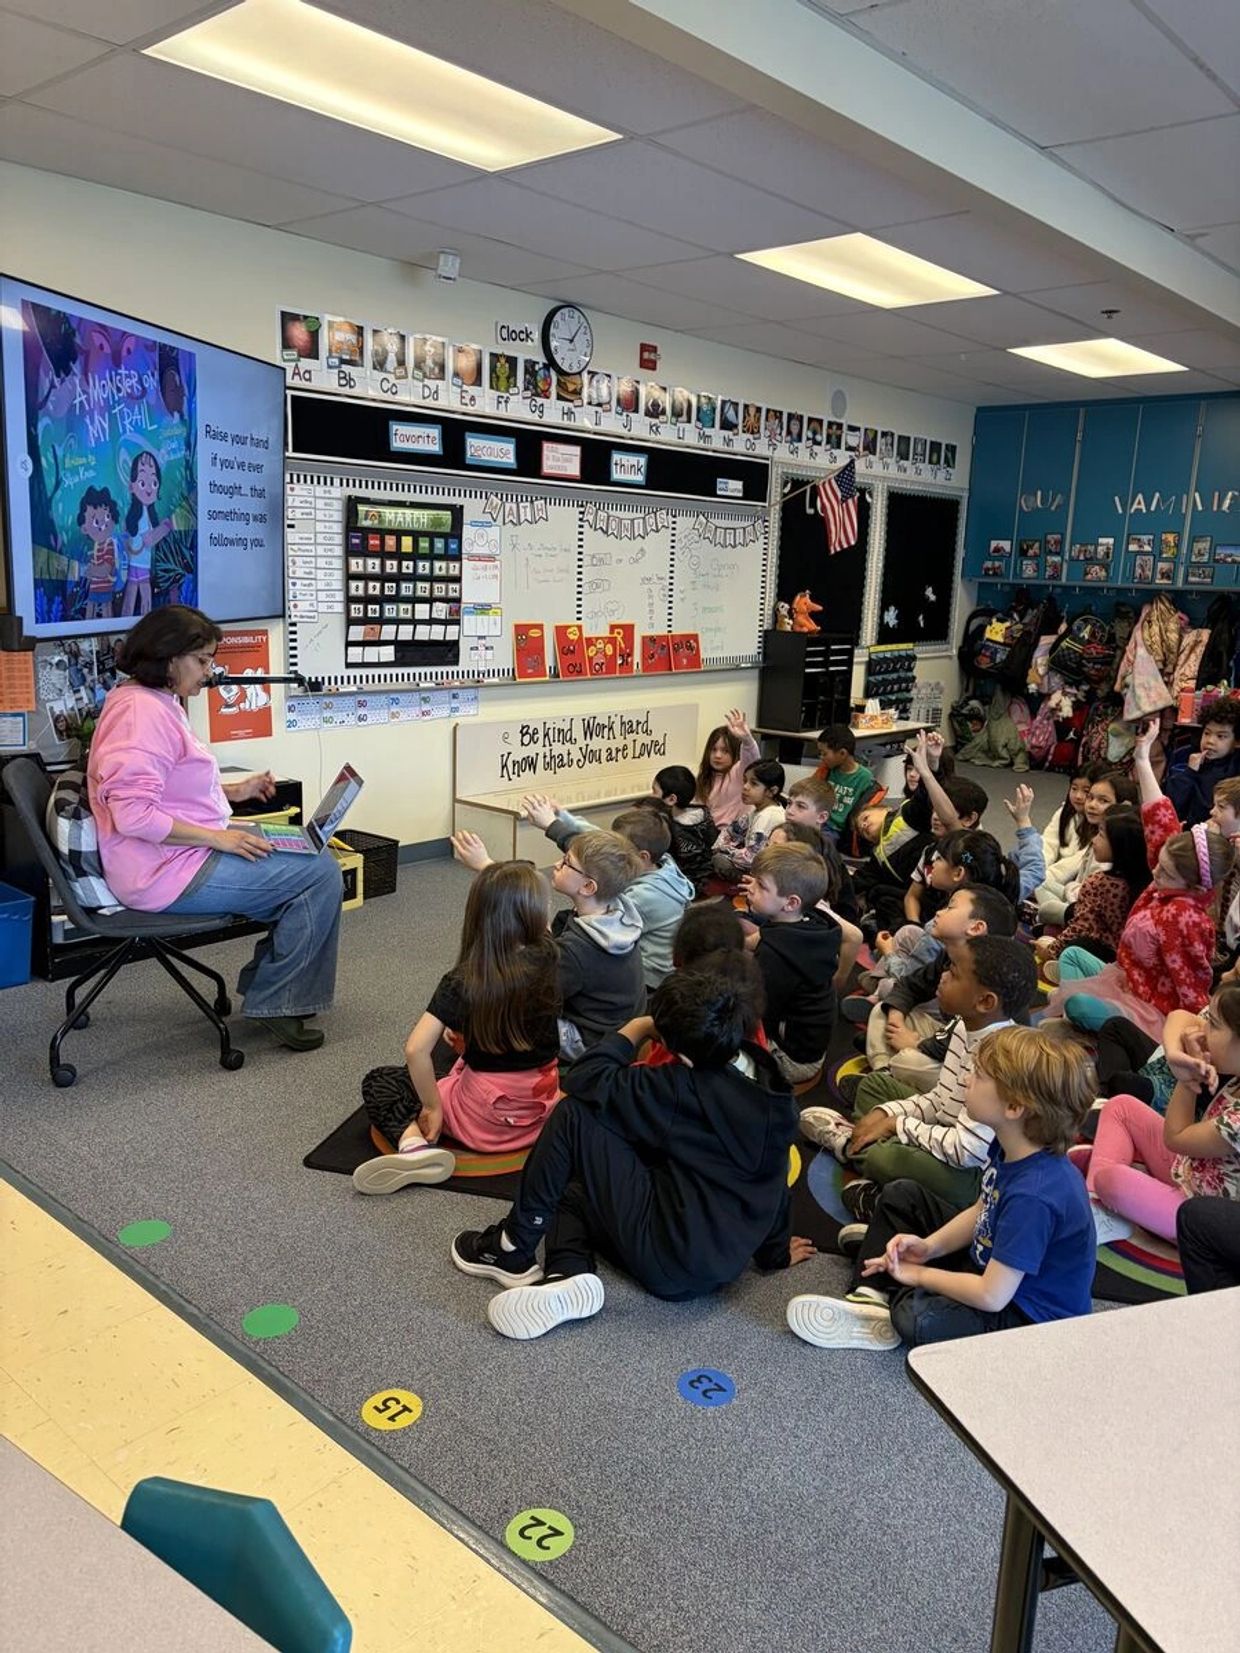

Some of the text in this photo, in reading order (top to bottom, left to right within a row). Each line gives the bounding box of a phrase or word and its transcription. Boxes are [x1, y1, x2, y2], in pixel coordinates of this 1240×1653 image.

[499, 324, 535, 343] Clock
[291, 363, 313, 383] Aa
[337, 370, 357, 389] Bb
[73, 375, 89, 415] A
[380, 377, 398, 396] Cc
[421, 384, 440, 401] Dd
[460, 389, 477, 407] Ee
[496, 395, 511, 413] Ff
[529, 398, 544, 419] Gg
[561, 406, 576, 423] Hh
[85, 400, 158, 448] MY TRAIL
[622, 413, 633, 432] Jj
[205, 424, 228, 442] Raise
[230, 433, 248, 447] your
[250, 433, 269, 450] hand
[394, 428, 437, 446] favorite
[697, 431, 713, 445] Mm
[722, 435, 734, 449] Nn
[469, 441, 512, 460] because
[210, 452, 264, 474] if you've ever
[614, 456, 644, 477] think
[250, 485, 266, 499] that
[207, 508, 267, 525] something was
[487, 498, 546, 519] MATH
[386, 511, 428, 528] MARCH
[586, 506, 667, 533] PHONICS
[209, 533, 265, 550] following you.
[354, 584, 359, 592] 8
[372, 584, 377, 592] 9
[420, 585, 427, 593] 12
[353, 607, 361, 615] 15
[288, 704, 296, 713] 10
[322, 701, 334, 710] 30
[357, 699, 368, 708] 50
[389, 697, 401, 705] 70
[286, 719, 298, 729] 20
[323, 715, 334, 725] 40
[357, 713, 368, 723] 60
[519, 710, 653, 748] Be kind, Work hard,
[500, 752, 539, 782] Know
[542, 749, 574, 775] that
[605, 743, 629, 763] are
[632, 733, 667, 760] Loved
[688, 1373, 729, 1400] 23
[373, 1396, 414, 1423] 15
[518, 1514, 565, 1551] 22
